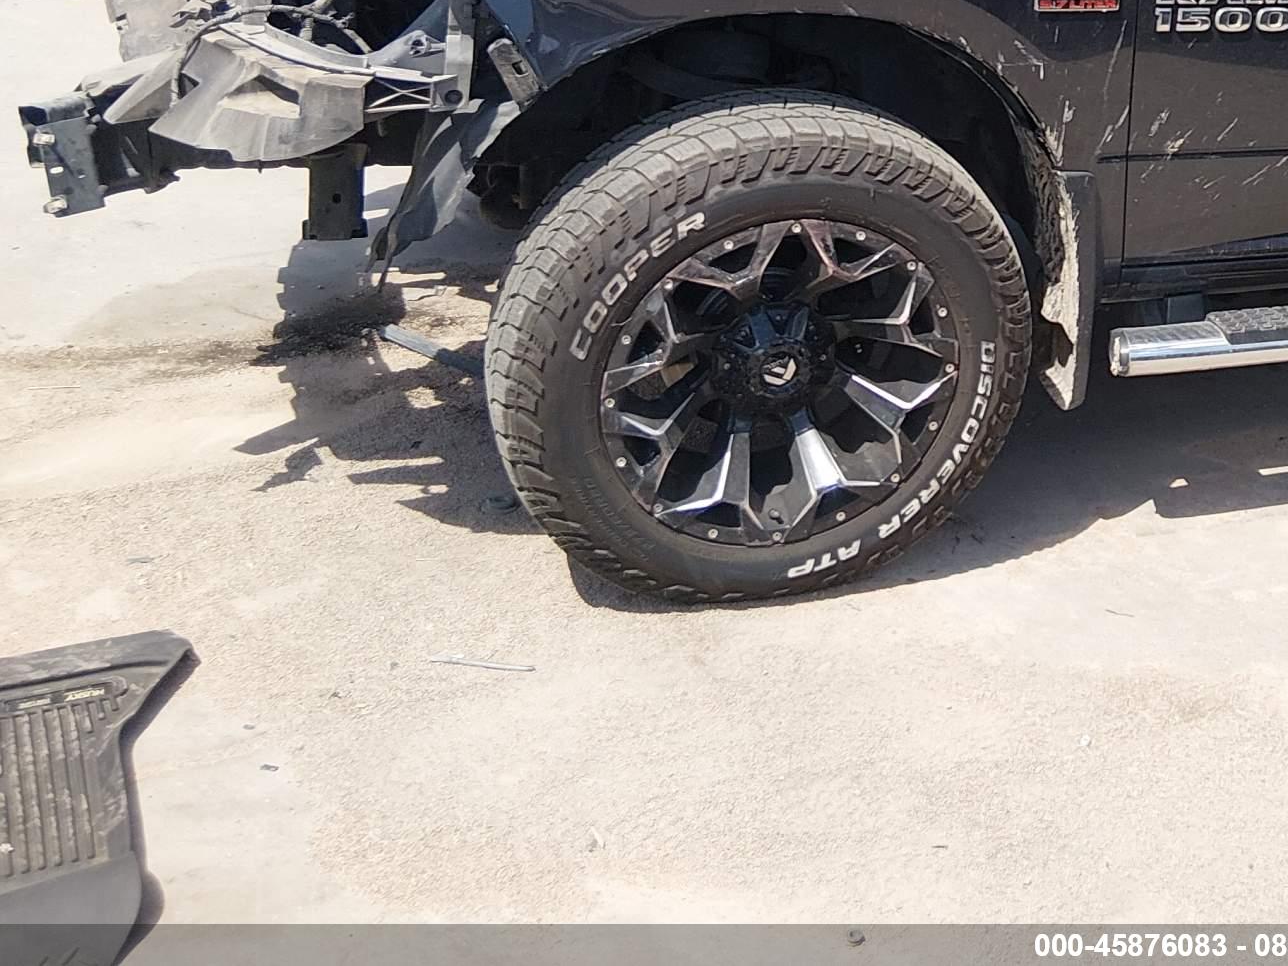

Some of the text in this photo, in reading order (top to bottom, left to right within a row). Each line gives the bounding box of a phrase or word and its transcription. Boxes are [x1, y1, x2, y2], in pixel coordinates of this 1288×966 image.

[568, 211, 706, 361] COOPER
[787, 340, 996, 578] DISCOVERER ATP
